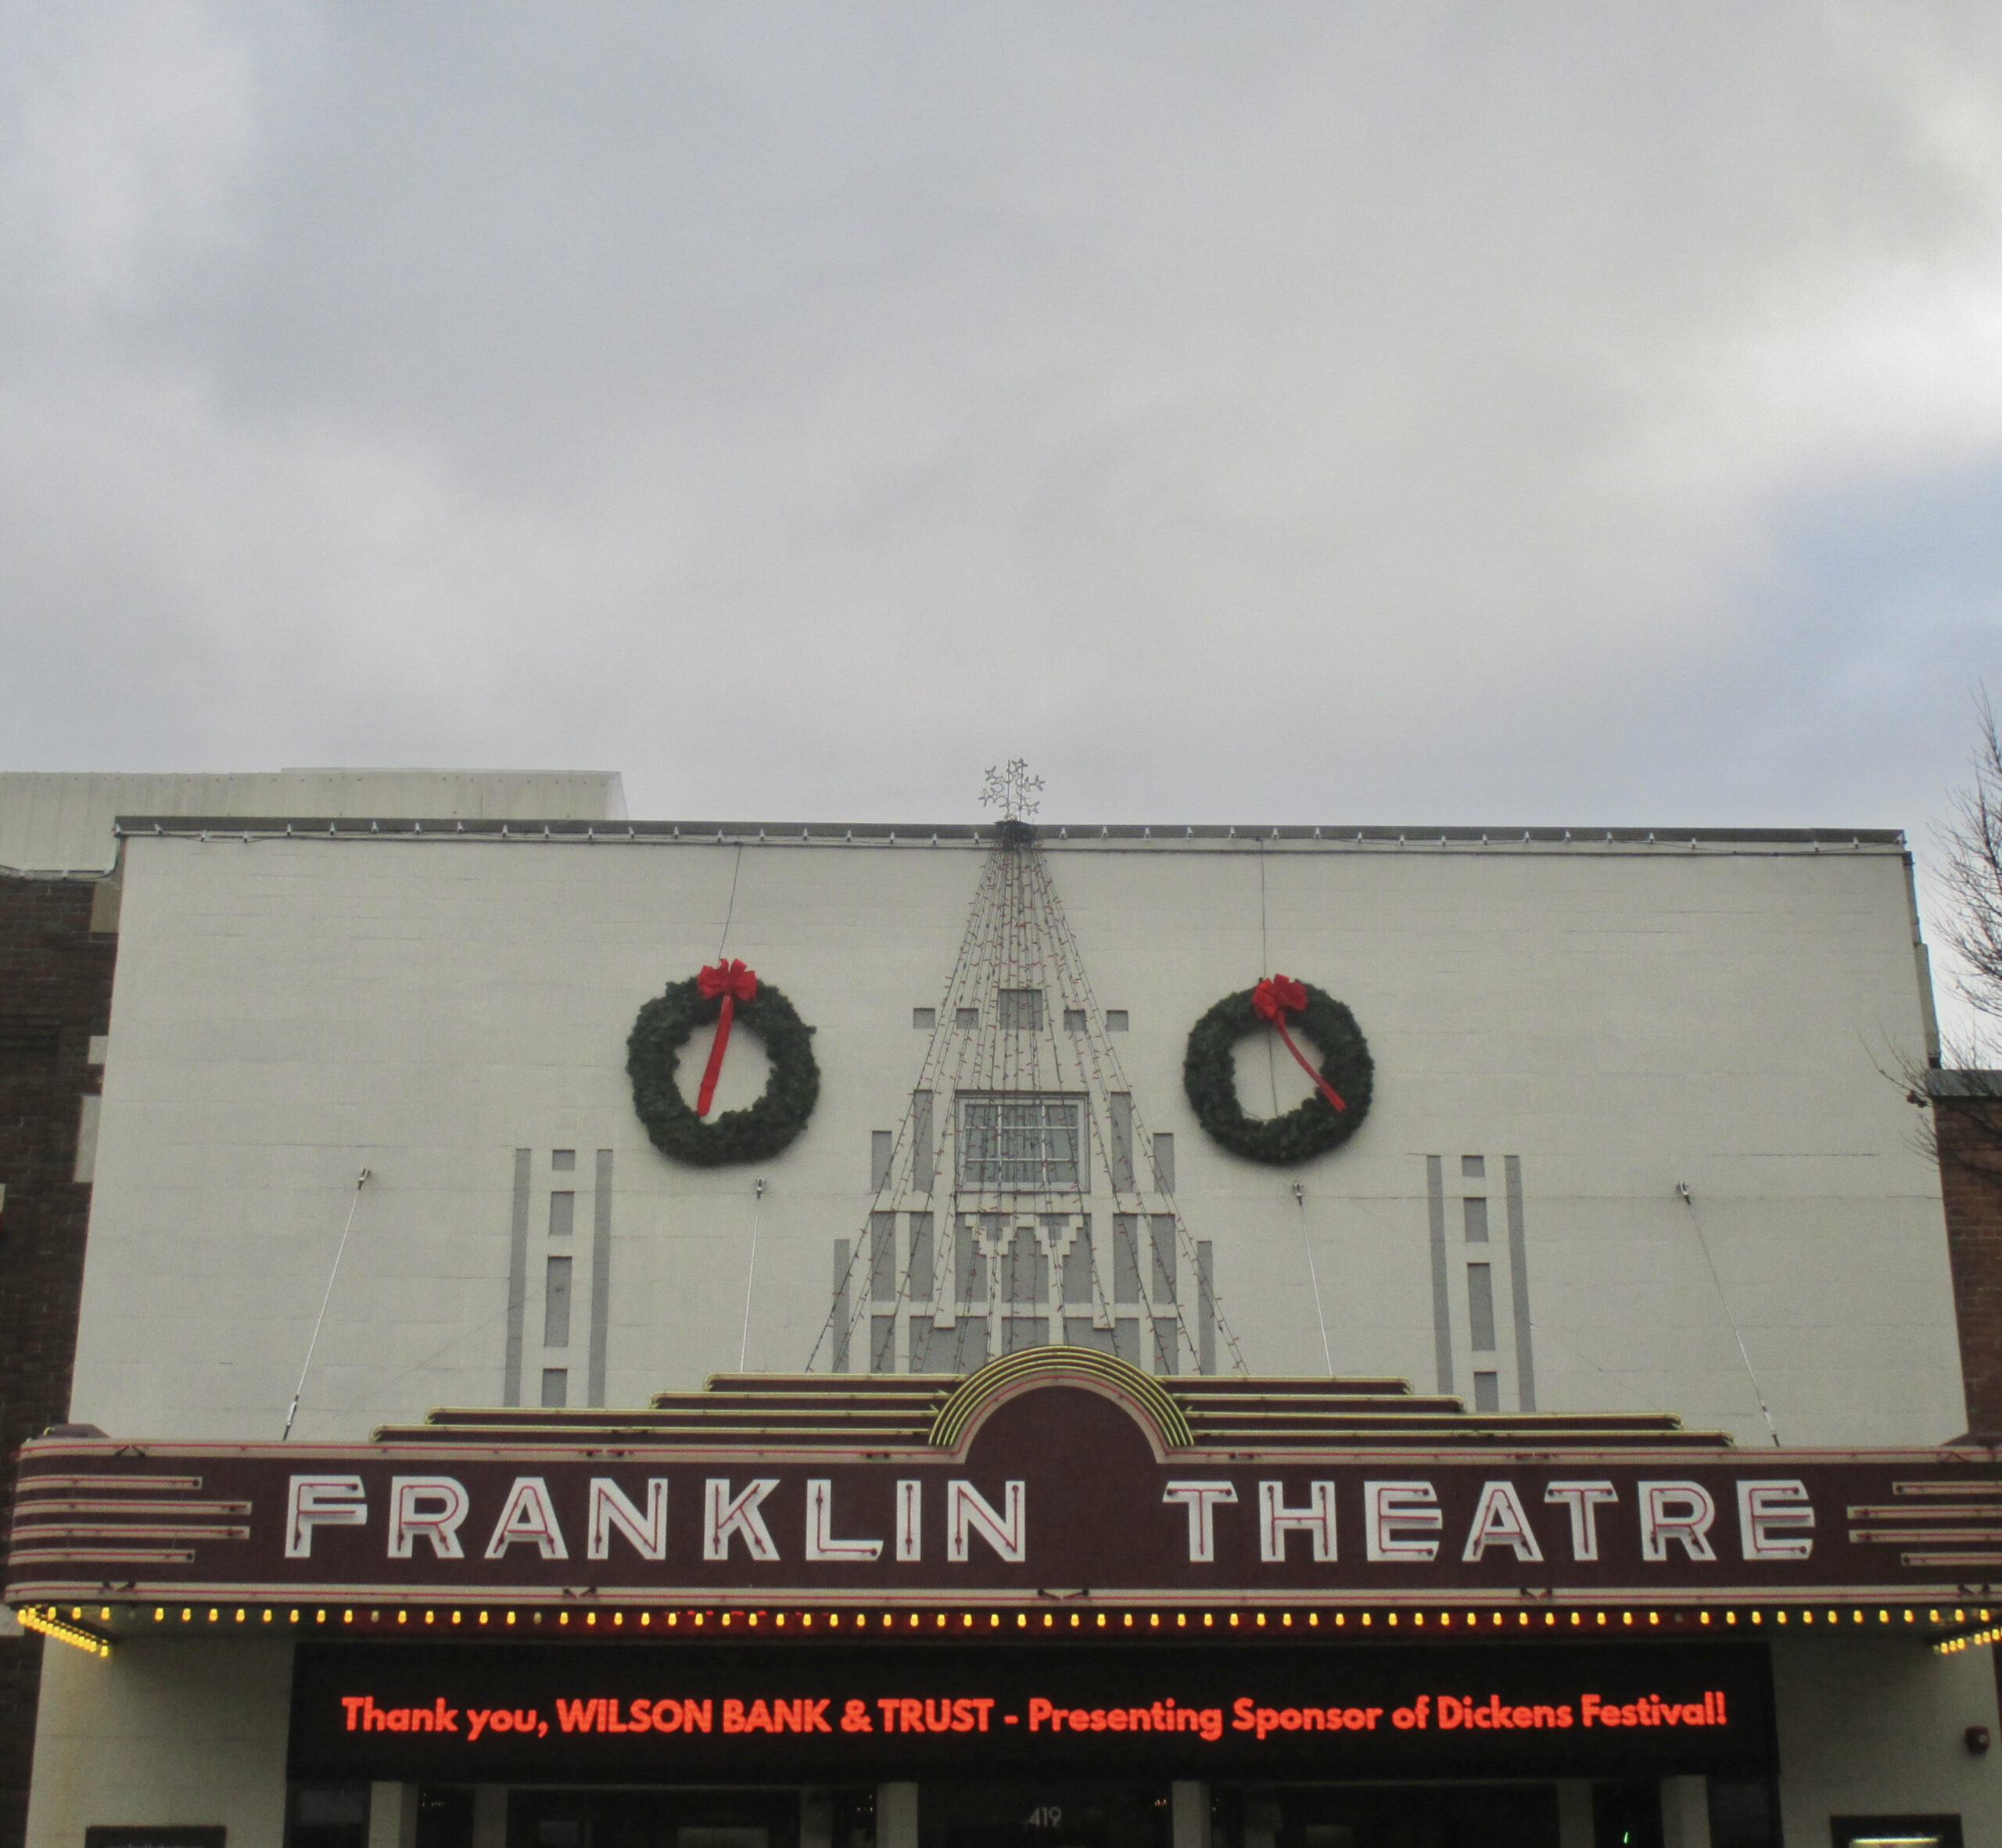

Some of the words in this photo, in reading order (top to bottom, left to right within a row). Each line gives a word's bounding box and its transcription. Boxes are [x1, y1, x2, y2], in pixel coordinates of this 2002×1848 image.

[283, 1474, 1028, 1564] FRANKLIN
[1162, 1477, 1816, 1564] THEATRE
[340, 1695, 458, 1731] Thank
[466, 1708, 549, 1741] you,
[555, 1697, 712, 1733] WILSON
[723, 1699, 833, 1733] BANK
[840, 1699, 874, 1732] &
[877, 1698, 995, 1732] TRUST
[1004, 1715, 1018, 1724] -
[1028, 1698, 1223, 1741] Presenting
[1232, 1696, 1383, 1740] Sponsor
[1392, 1694, 1430, 1730] of
[1437, 1693, 1573, 1729] Dickens
[1580, 1691, 1728, 1727] Festival!
[1028, 1807, 1062, 1828] 419
